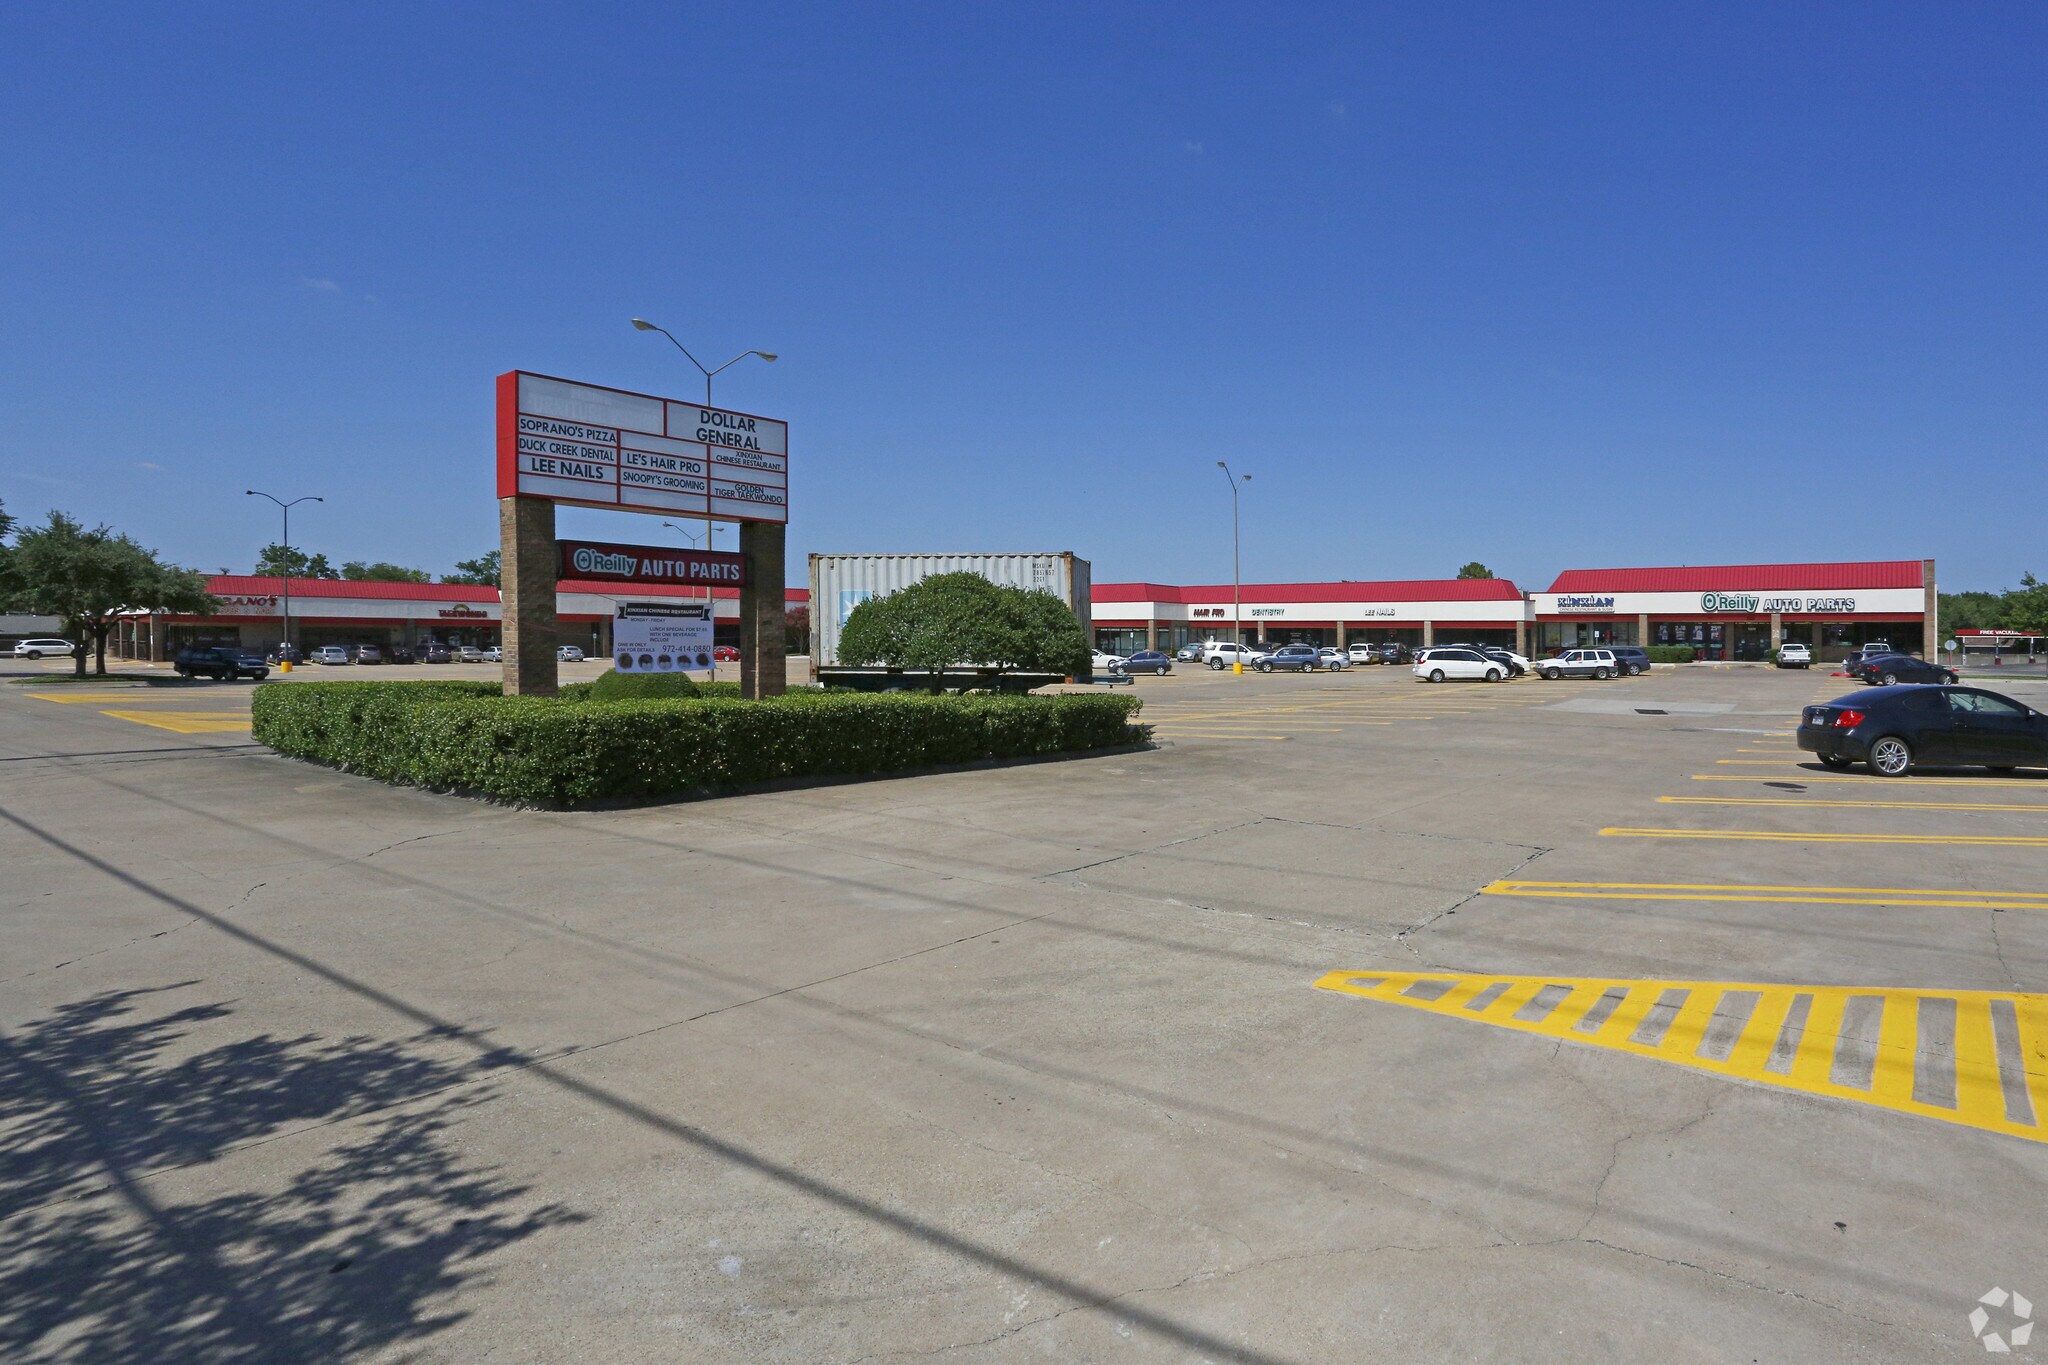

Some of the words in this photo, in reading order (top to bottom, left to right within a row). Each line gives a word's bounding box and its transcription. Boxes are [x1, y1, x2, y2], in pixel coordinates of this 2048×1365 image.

[519, 418, 584, 438] SOPRANO'S
[586, 429, 617, 444] PIZZA
[700, 410, 756, 432] DOLLAR
[696, 427, 761, 451] GENERAL
[519, 437, 546, 452] DUCK
[549, 442, 578, 457] CREEK
[580, 447, 615, 462] DENTAL
[735, 450, 763, 461] XINXIAN
[531, 457, 556, 474] LEE
[560, 462, 604, 480] NAILS
[626, 452, 648, 466] LE'S
[650, 456, 677, 470] HAIR
[679, 459, 701, 474] PRO
[715, 454, 741, 465] CHINESE
[742, 457, 781, 470] RESTAURANT
[623, 471, 662, 486] SNOOPY'S
[663, 476, 705, 491] GROOMING
[734, 483, 764, 494] GOLDEN
[714, 488, 736, 498] TIGER
[737, 490, 783, 504] TAEKWONDO
[573, 548, 637, 577] O'Reilly
[641, 559, 686, 578] AUTO
[690, 562, 740, 581] PARTS
[1558, 594, 1615, 607] XINXIAN
[1701, 591, 1760, 613] O'Reilly
[1763, 598, 1802, 612] AUTO
[1806, 597, 1856, 612] PARTS
[1193, 608, 1211, 618] HAIR
[1211, 608, 1225, 618] PRO
[1251, 608, 1285, 617] DENTISTRY
[1376, 608, 1396, 616] NAILS
